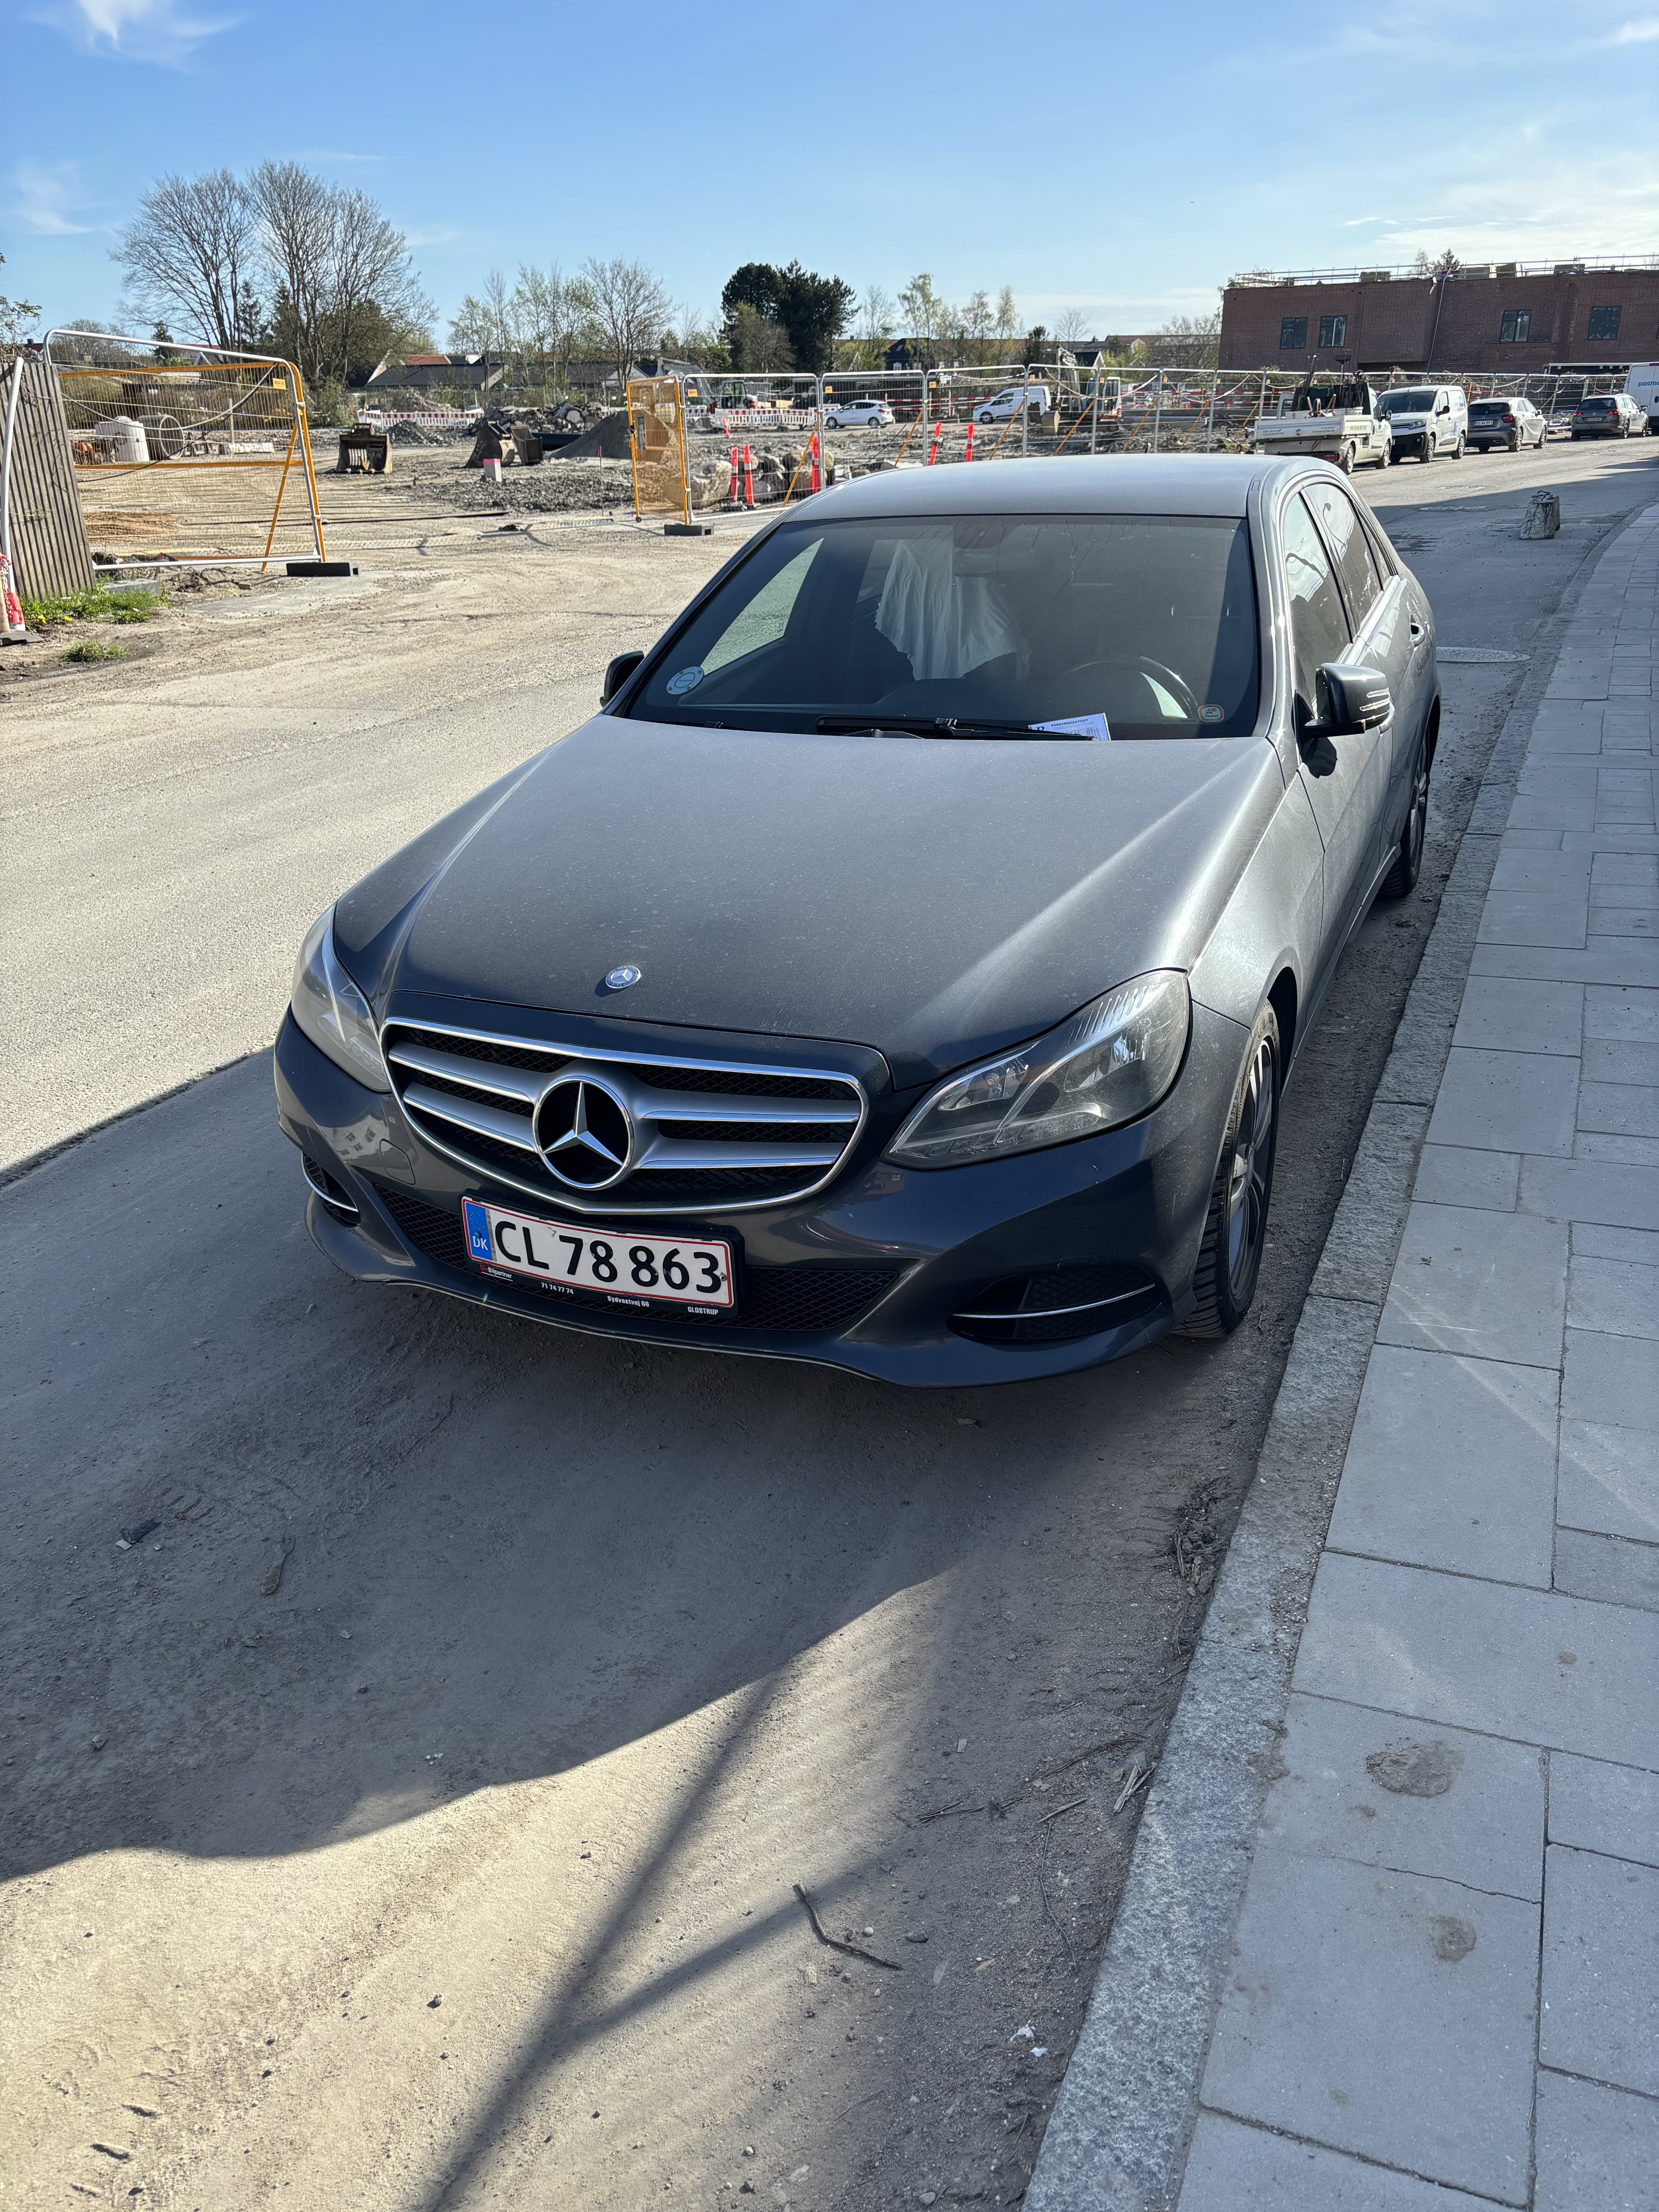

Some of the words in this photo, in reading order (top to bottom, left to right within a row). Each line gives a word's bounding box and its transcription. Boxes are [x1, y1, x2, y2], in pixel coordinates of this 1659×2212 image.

[472, 1235, 488, 1250] DK
[495, 1220, 550, 1270] CL
[559, 1235, 618, 1283] 78
[629, 1245, 721, 1293] 863
[607, 1295, 641, 1307] Sydvestvej
[687, 1306, 718, 1315] GLOSTRUP
